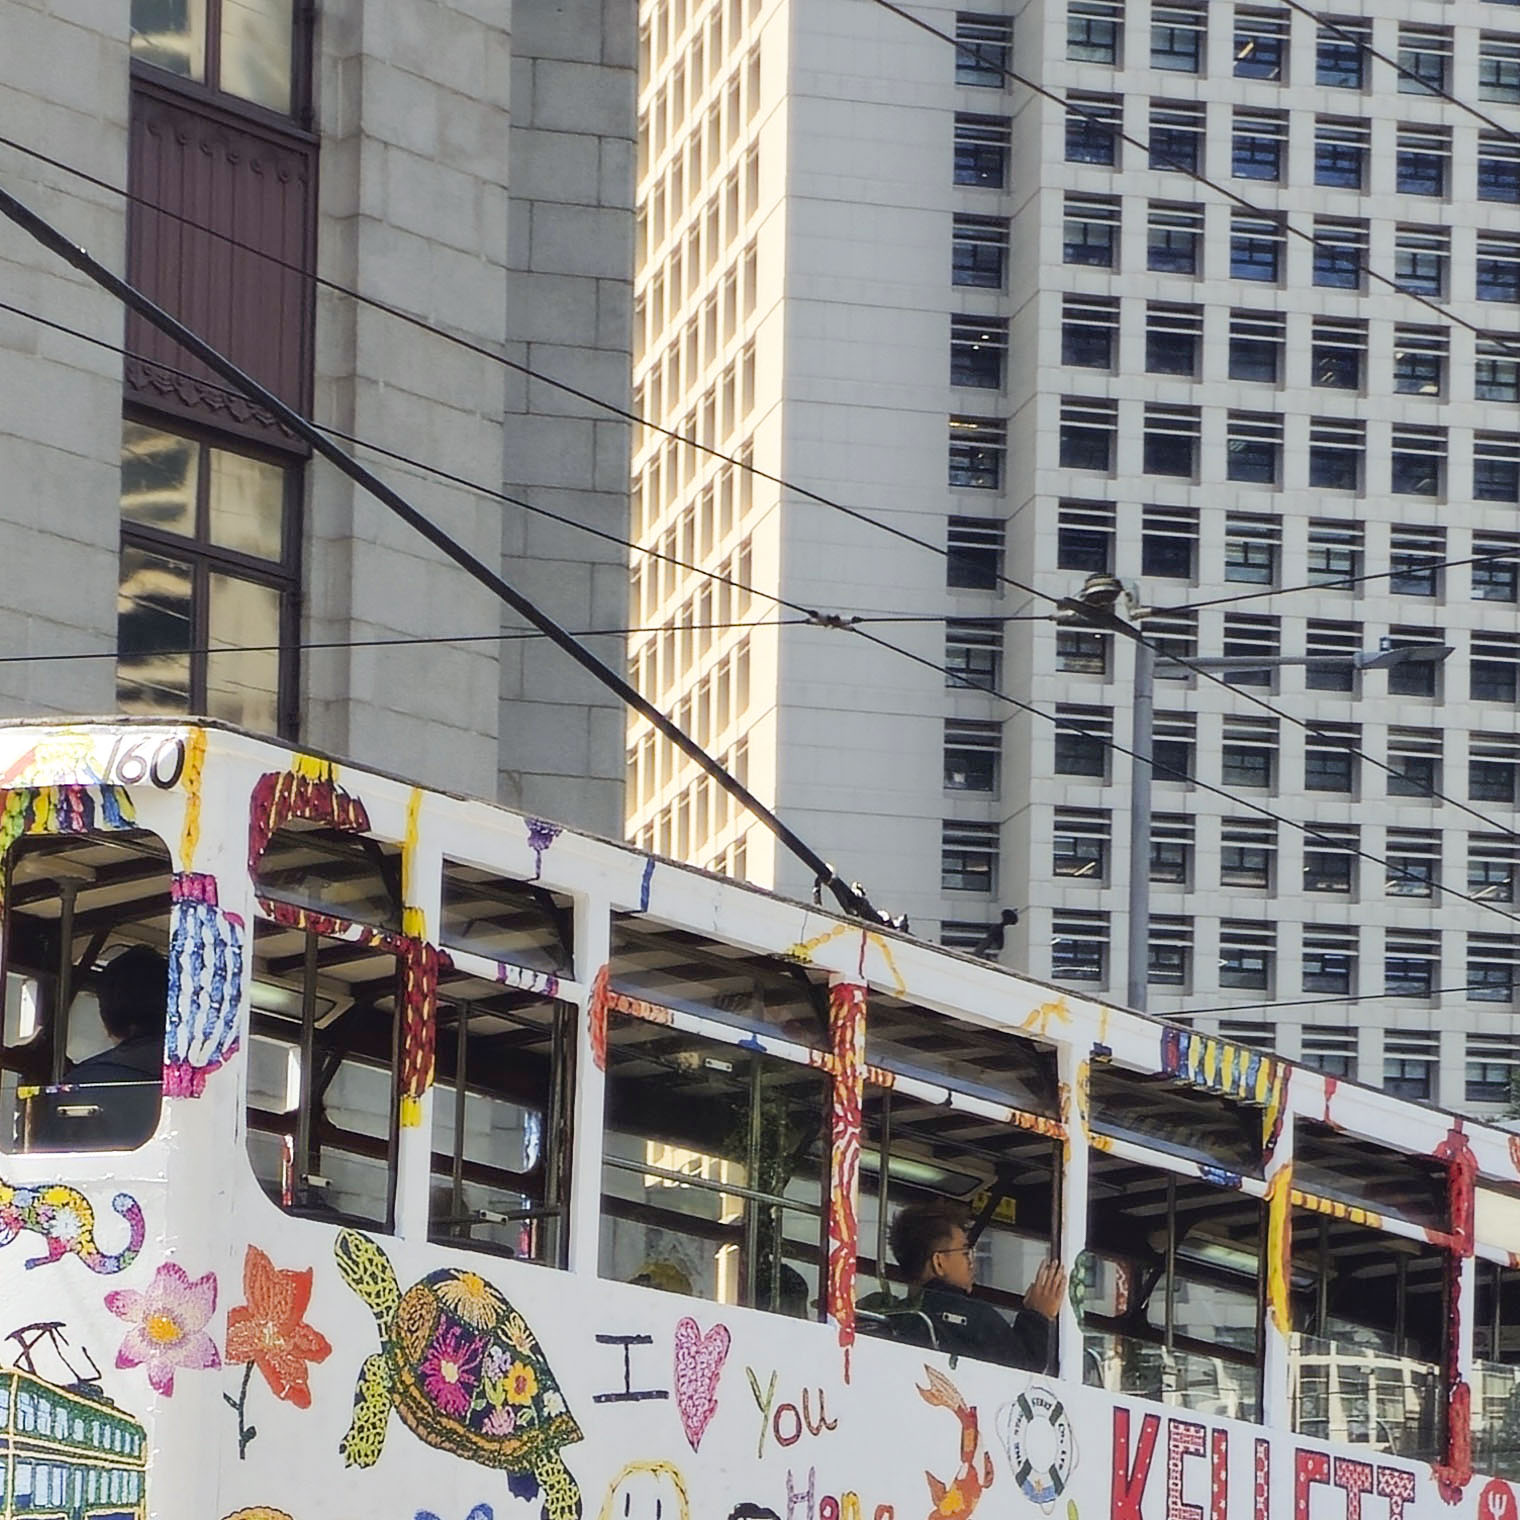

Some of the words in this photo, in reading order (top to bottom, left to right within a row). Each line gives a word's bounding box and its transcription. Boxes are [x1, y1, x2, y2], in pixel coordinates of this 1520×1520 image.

[103, 735, 185, 790] 160
[593, 1334, 669, 1403] I
[746, 1366, 838, 1459] You
